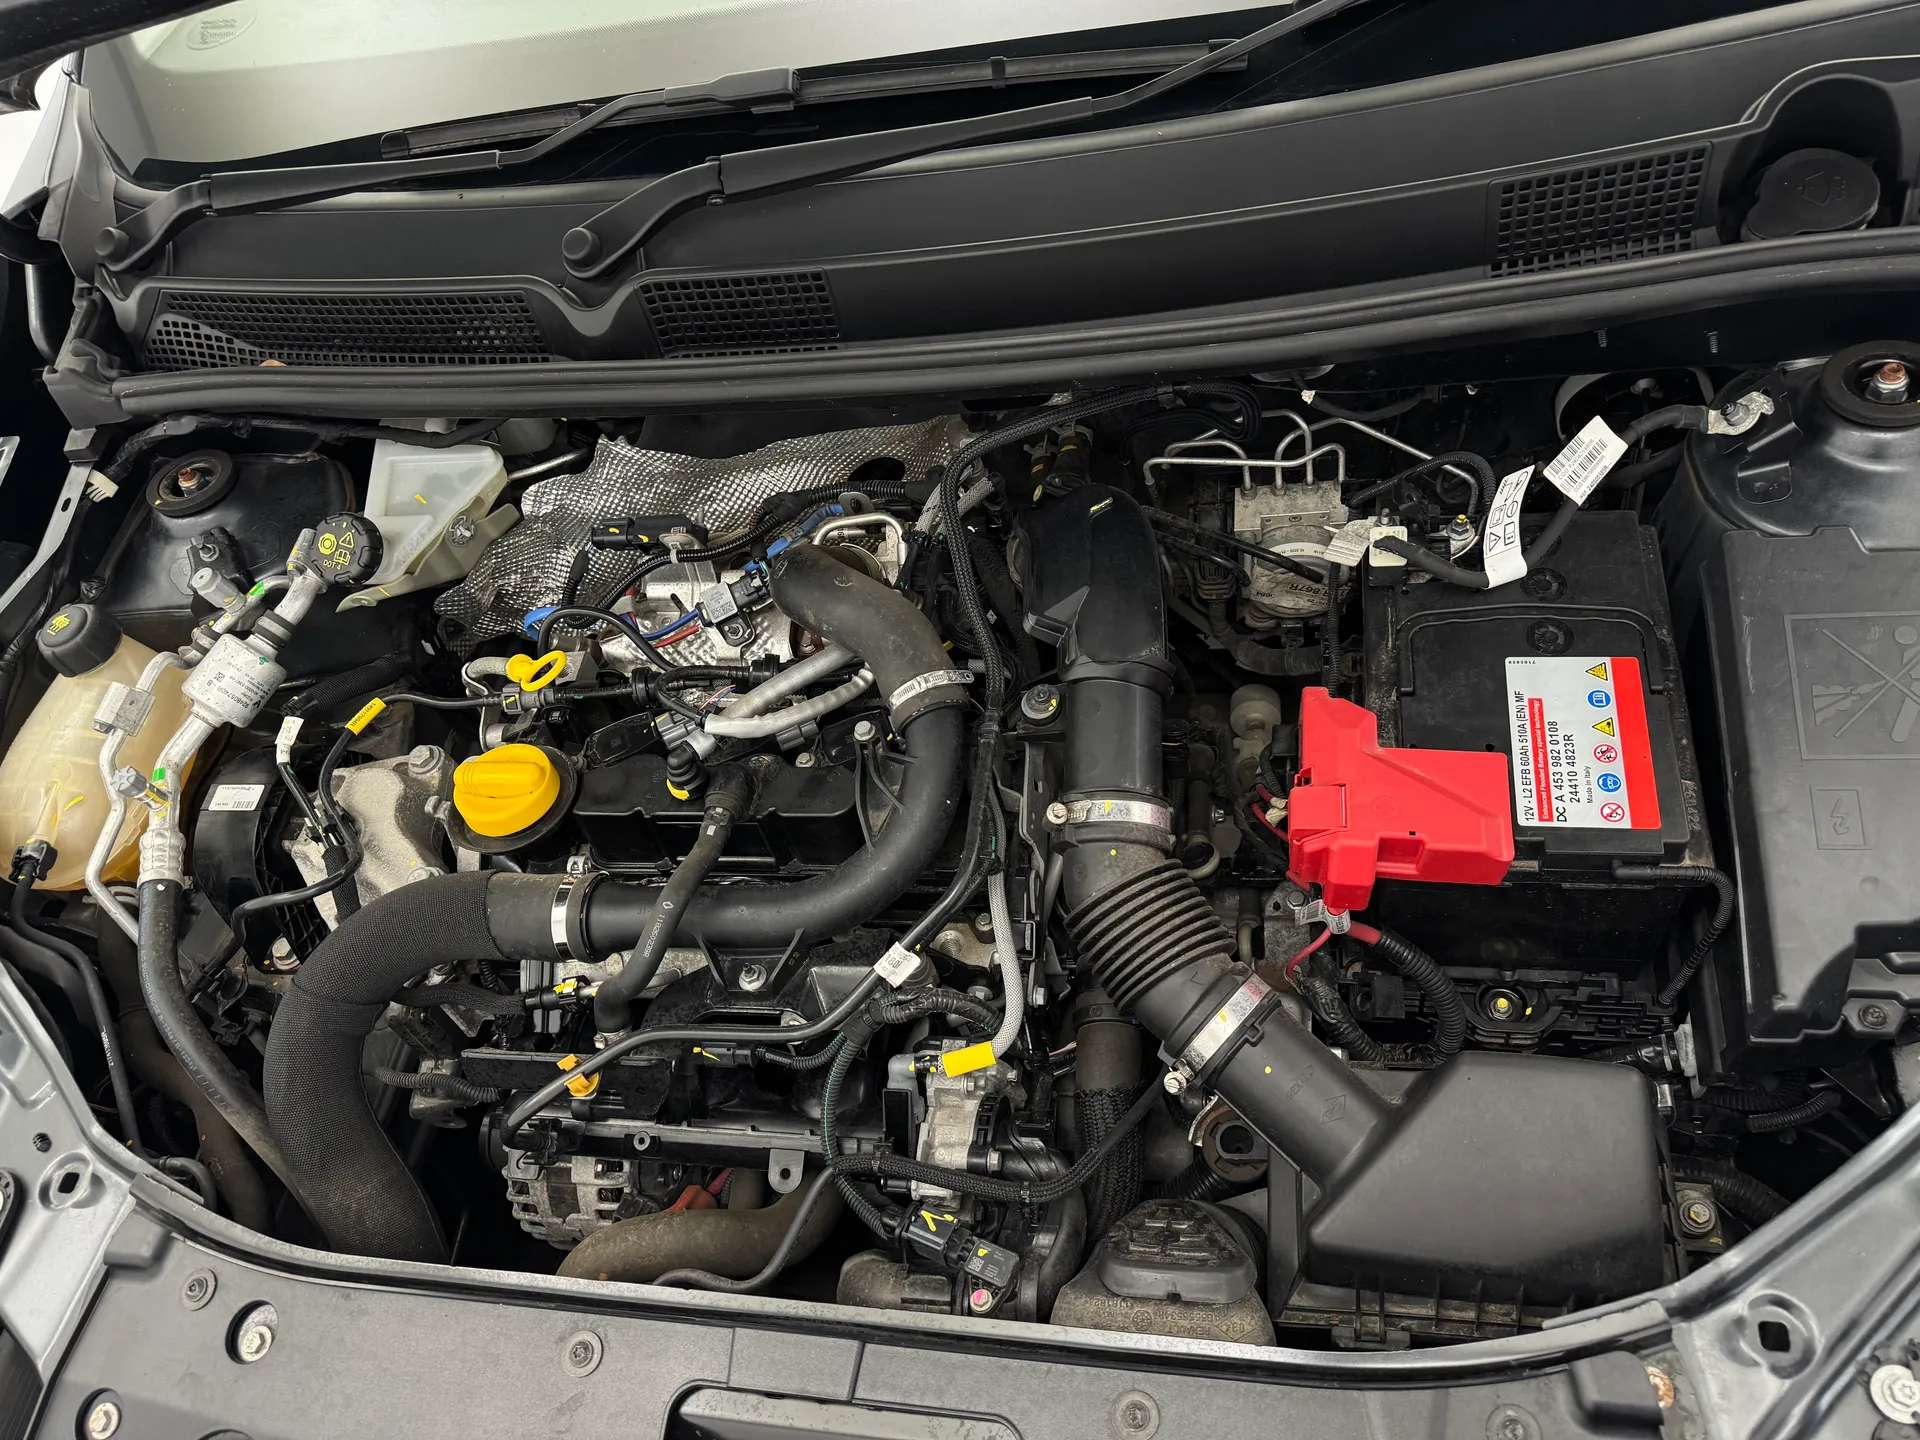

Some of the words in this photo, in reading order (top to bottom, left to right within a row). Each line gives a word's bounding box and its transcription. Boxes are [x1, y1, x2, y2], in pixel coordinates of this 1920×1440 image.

[323, 560, 335, 568] DOT
[1514, 690, 1524, 702] MF
[1516, 704, 1528, 722] (EN)
[1533, 700, 1541, 728] technology
[1517, 722, 1528, 744] 510A
[1548, 720, 1560, 746] 0108
[1520, 746, 1530, 766] 60Ah
[1550, 749, 1562, 768] 982
[1563, 734, 1576, 767] 4823R
[1520, 768, 1532, 786] EFB
[1552, 771, 1564, 790] 453
[1584, 766, 1592, 778] Italy
[1522, 788, 1532, 798] L2
[1566, 770, 1580, 803] 24410
[1554, 794, 1566, 802] A
[1524, 806, 1534, 821] 12V
